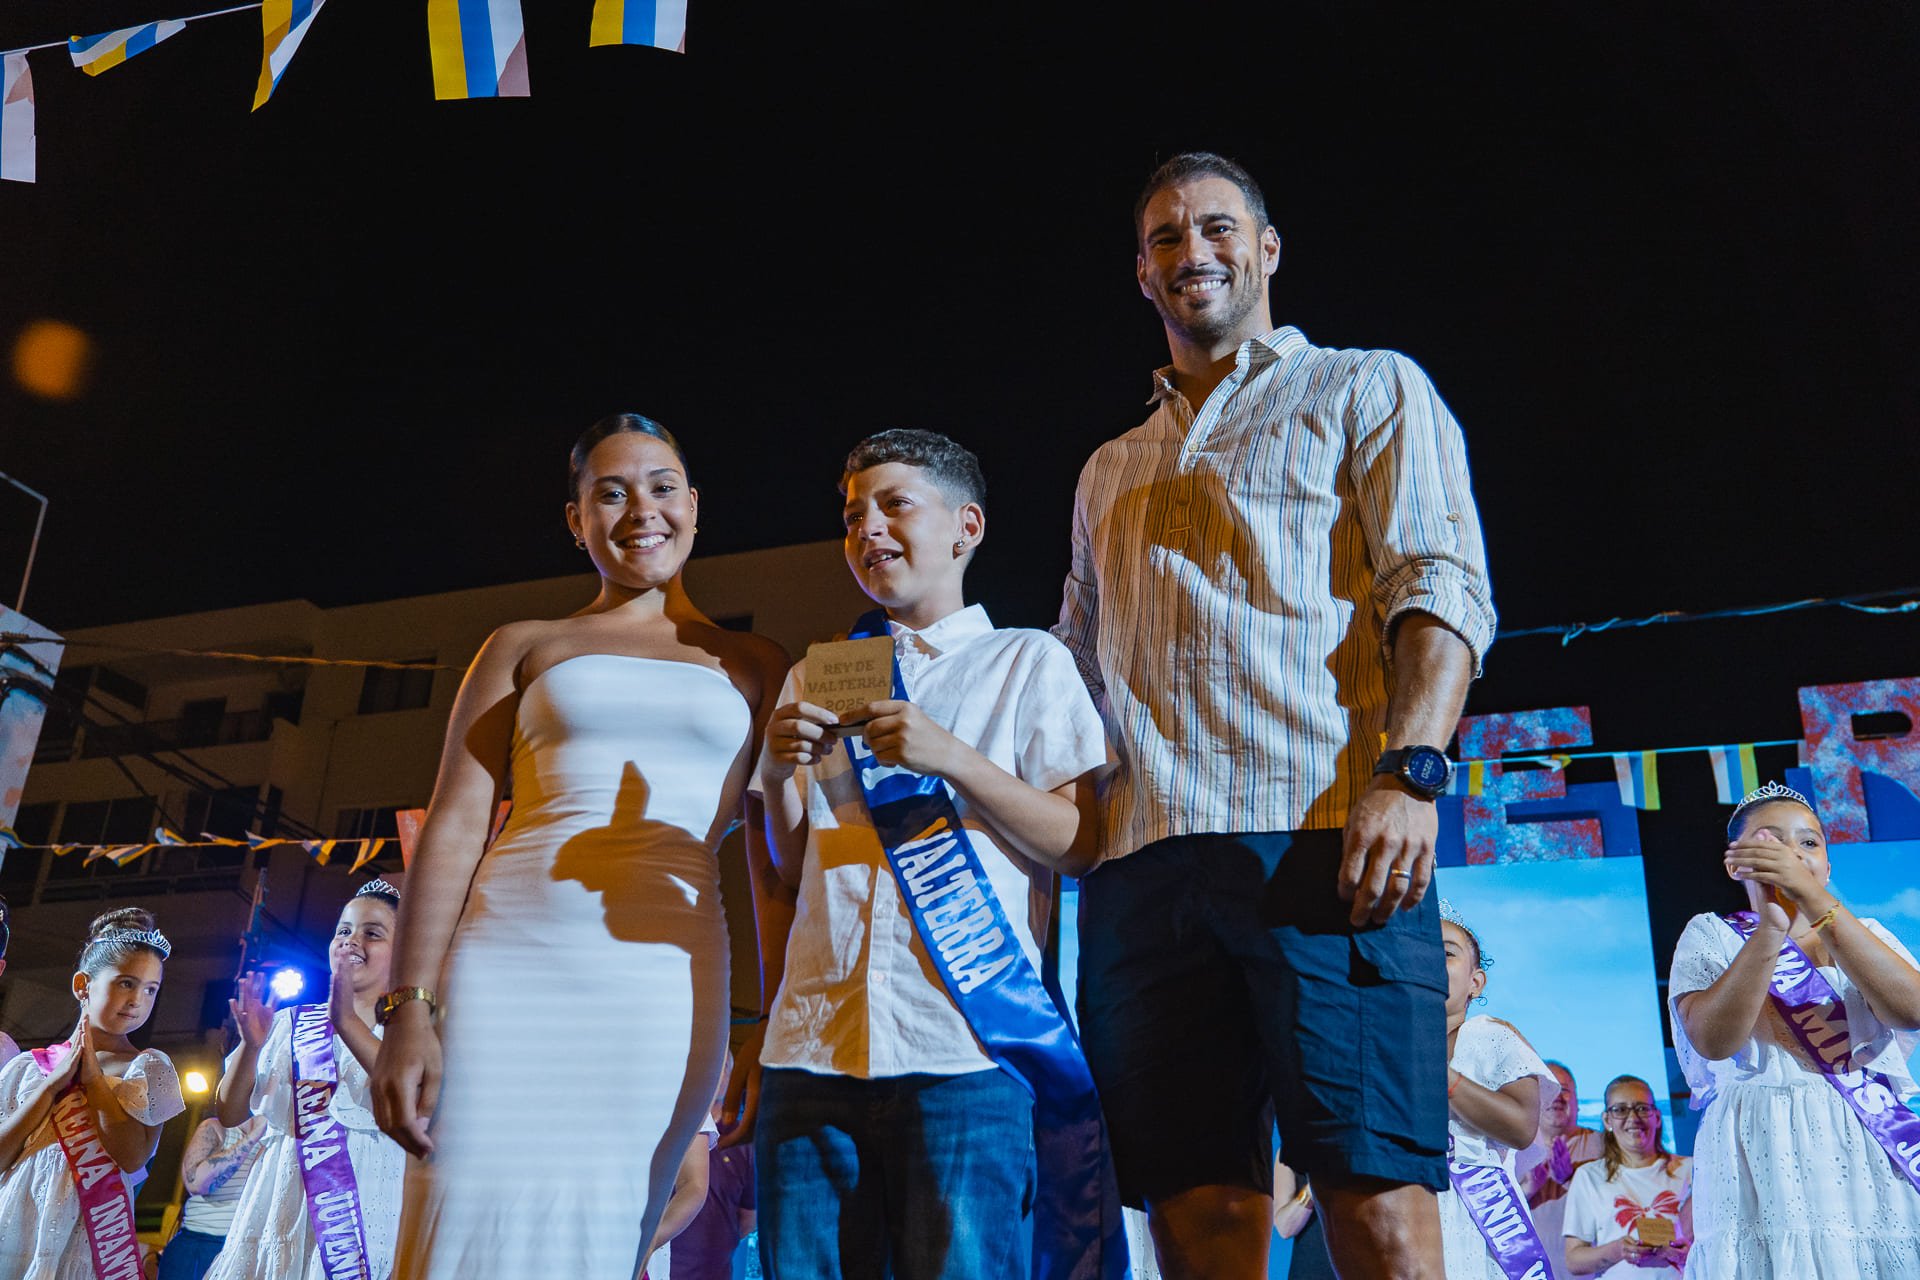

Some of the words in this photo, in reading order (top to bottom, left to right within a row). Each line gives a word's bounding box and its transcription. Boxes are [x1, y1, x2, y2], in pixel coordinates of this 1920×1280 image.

[807, 675, 887, 693] VALTERRA
[823, 662, 853, 675] REY
[855, 660, 875, 673] DE
[893, 816, 1015, 994] VALTERRA
[297, 1066, 341, 1171] REINA
[53, 1089, 117, 1190] REINA
[90, 1194, 139, 1280] INFANT
[314, 1190, 368, 1280] JUVENI
